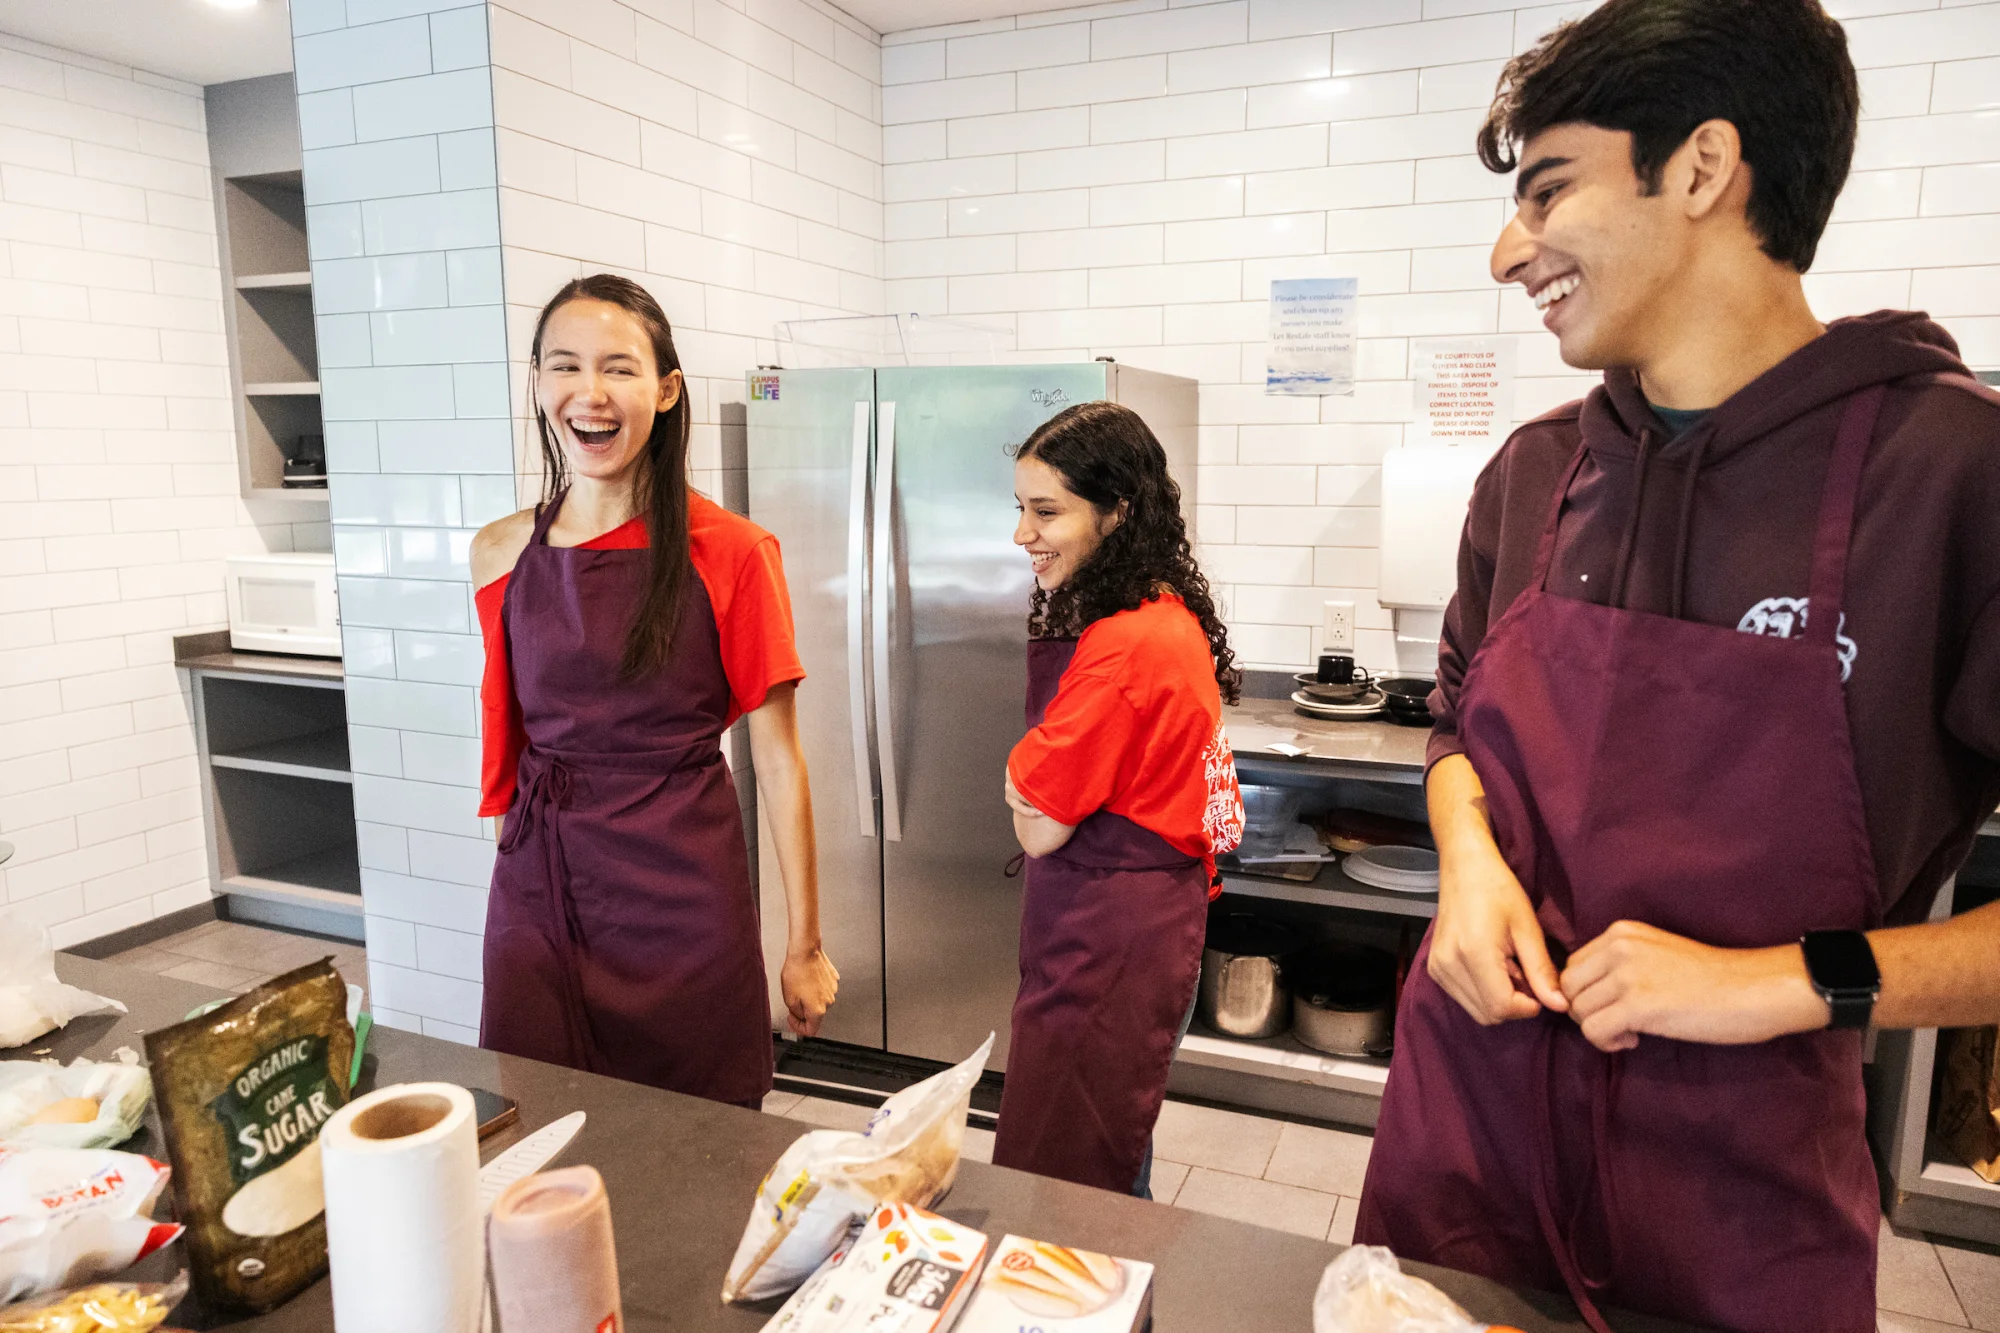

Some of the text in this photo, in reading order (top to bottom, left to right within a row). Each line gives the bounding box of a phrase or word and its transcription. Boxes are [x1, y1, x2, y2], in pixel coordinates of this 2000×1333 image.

[1275, 294, 1298, 302] Please
[1309, 292, 1355, 301] considerate
[1282, 306, 1344, 315] and clean up any
[1307, 320, 1321, 328] you
[1323, 318, 1343, 326] make
[1272, 332, 1284, 341] Let
[1313, 331, 1330, 339] staff
[1331, 331, 1351, 339] know
[1281, 346, 1295, 354] you
[1296, 344, 1314, 352] need
[1432, 362, 1458, 370] OTHERS
[751, 376, 779, 384] CAMPUS
[1461, 381, 1488, 389] DISPOSE
[751, 383, 780, 401] LIFE
[1437, 391, 1457, 399] ITEMS
[235, 1039, 309, 1098] ORGANIC
[264, 1083, 298, 1116] CANE
